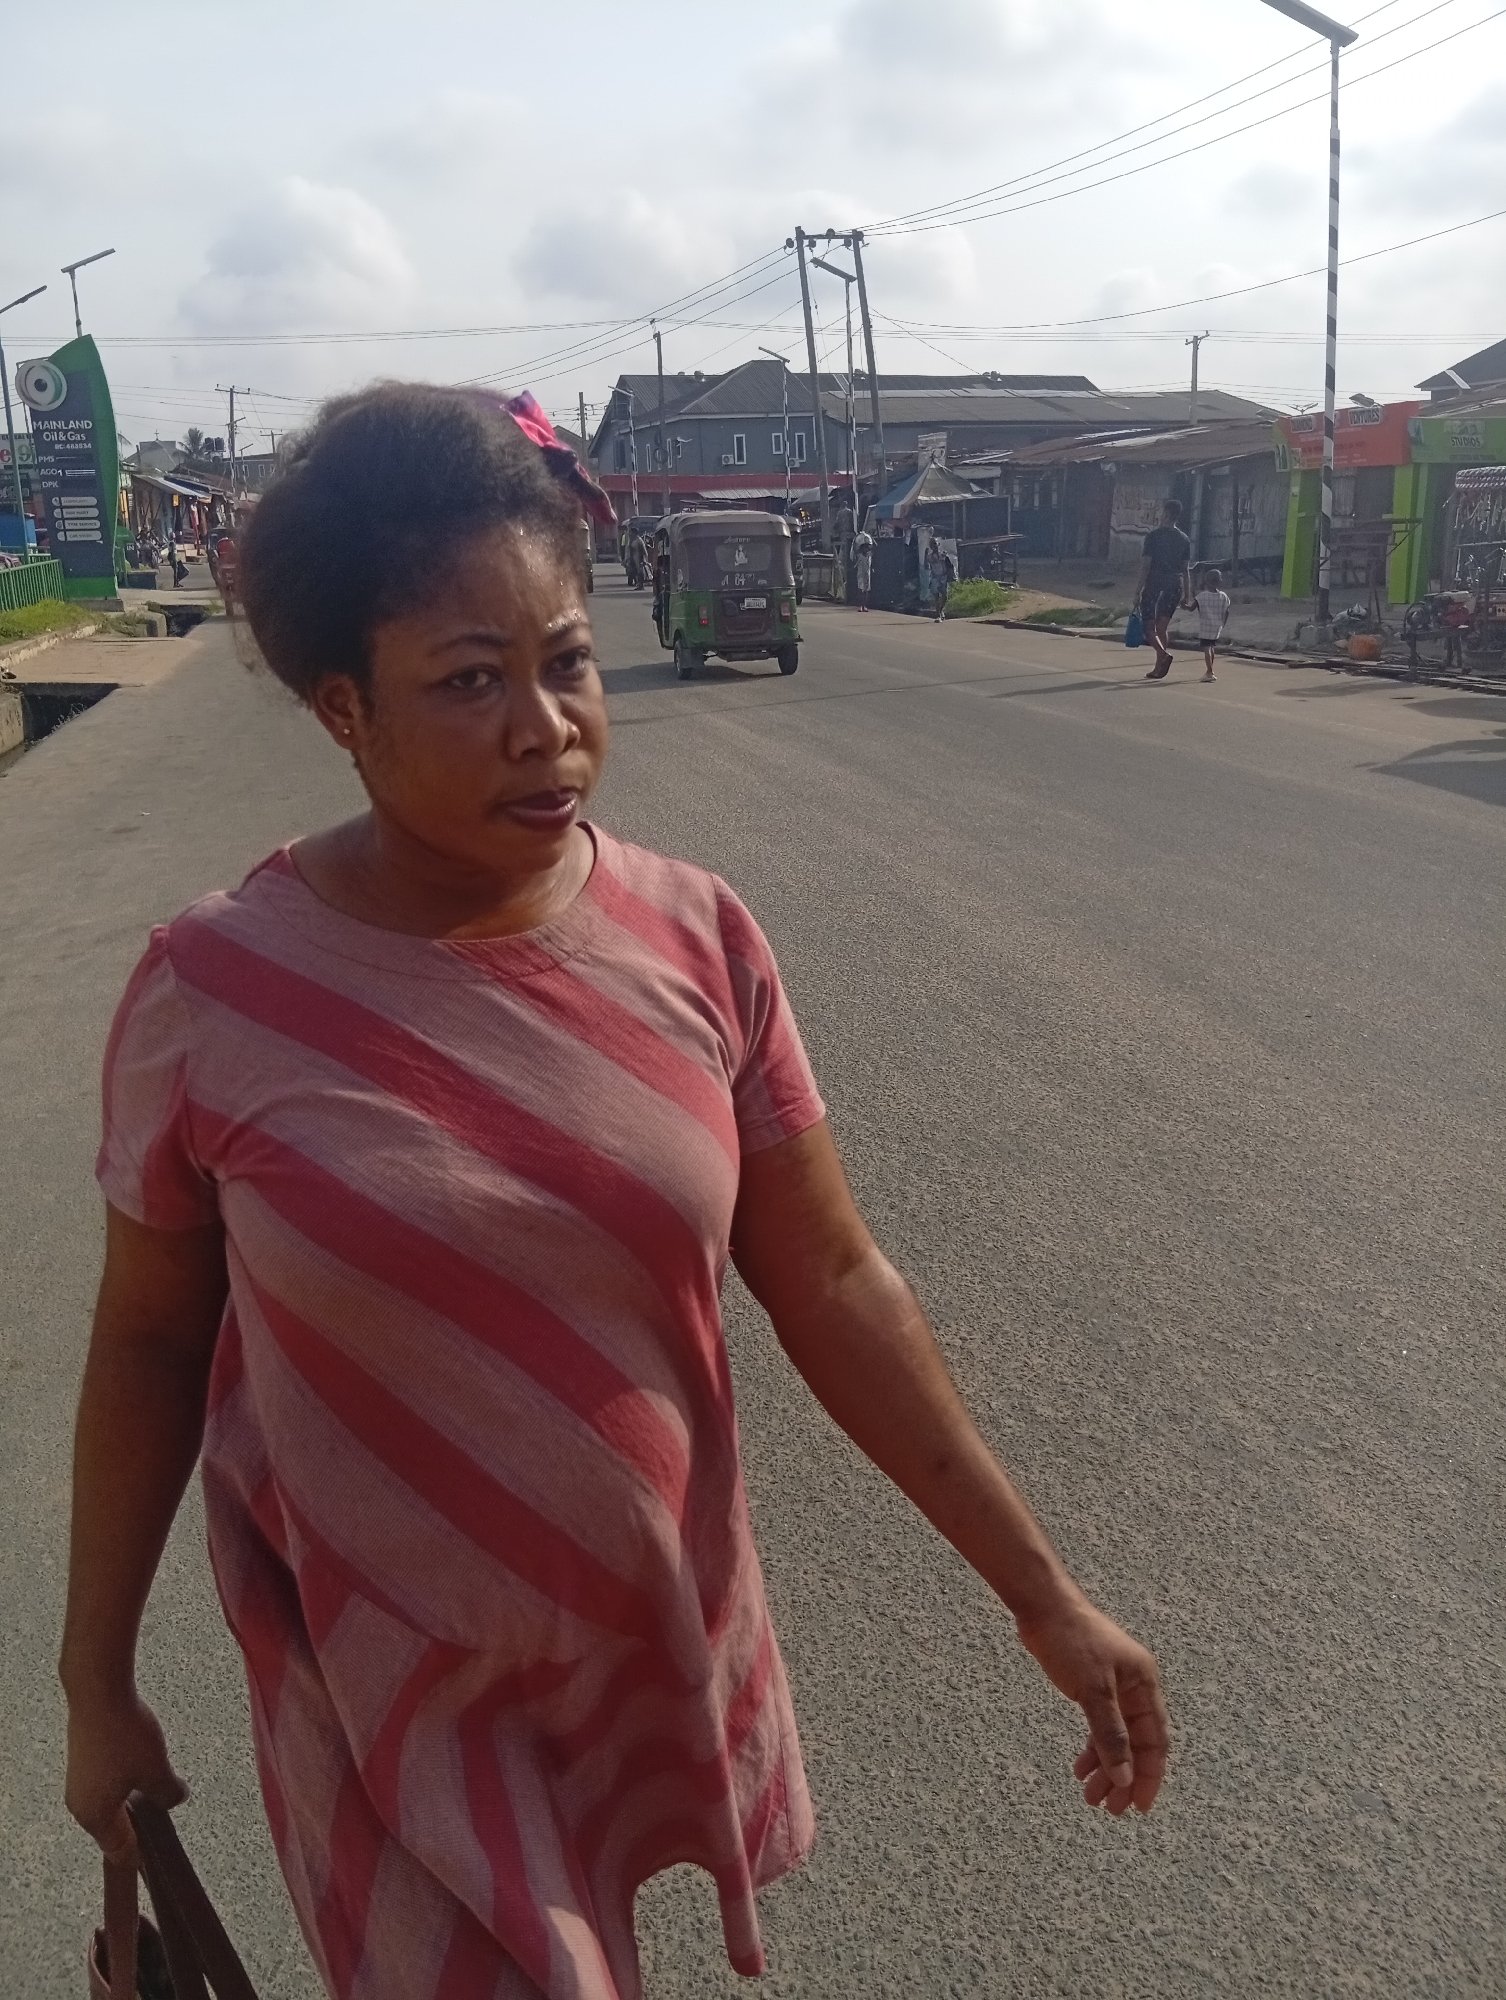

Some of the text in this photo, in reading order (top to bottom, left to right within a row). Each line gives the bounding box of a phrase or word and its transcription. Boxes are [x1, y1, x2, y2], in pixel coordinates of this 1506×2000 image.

[1349, 408, 1380, 425] VENTURES
[33, 420, 93, 430] MAINLAND
[1451, 436, 1481, 448] STUDIOS
[38, 455, 55, 463] PMS
